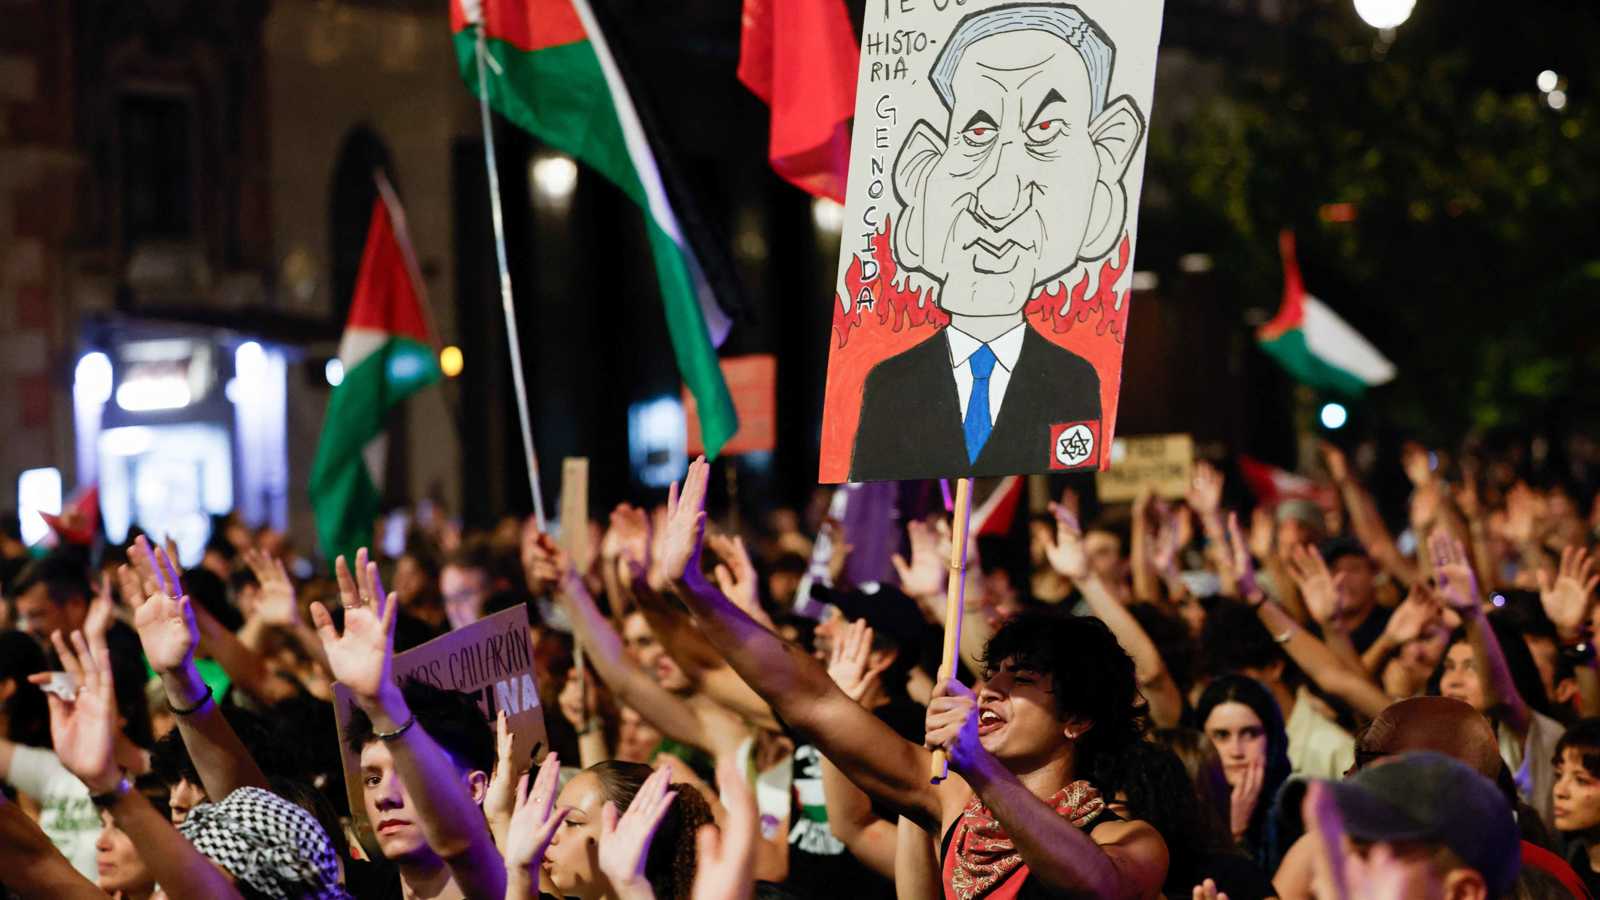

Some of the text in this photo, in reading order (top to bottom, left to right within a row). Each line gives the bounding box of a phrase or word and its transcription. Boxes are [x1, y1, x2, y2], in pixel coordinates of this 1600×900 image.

[867, 29, 937, 56] HISTO-
[856, 94, 897, 312] GENOCIDA
[449, 621, 531, 689] CALLARÁN
